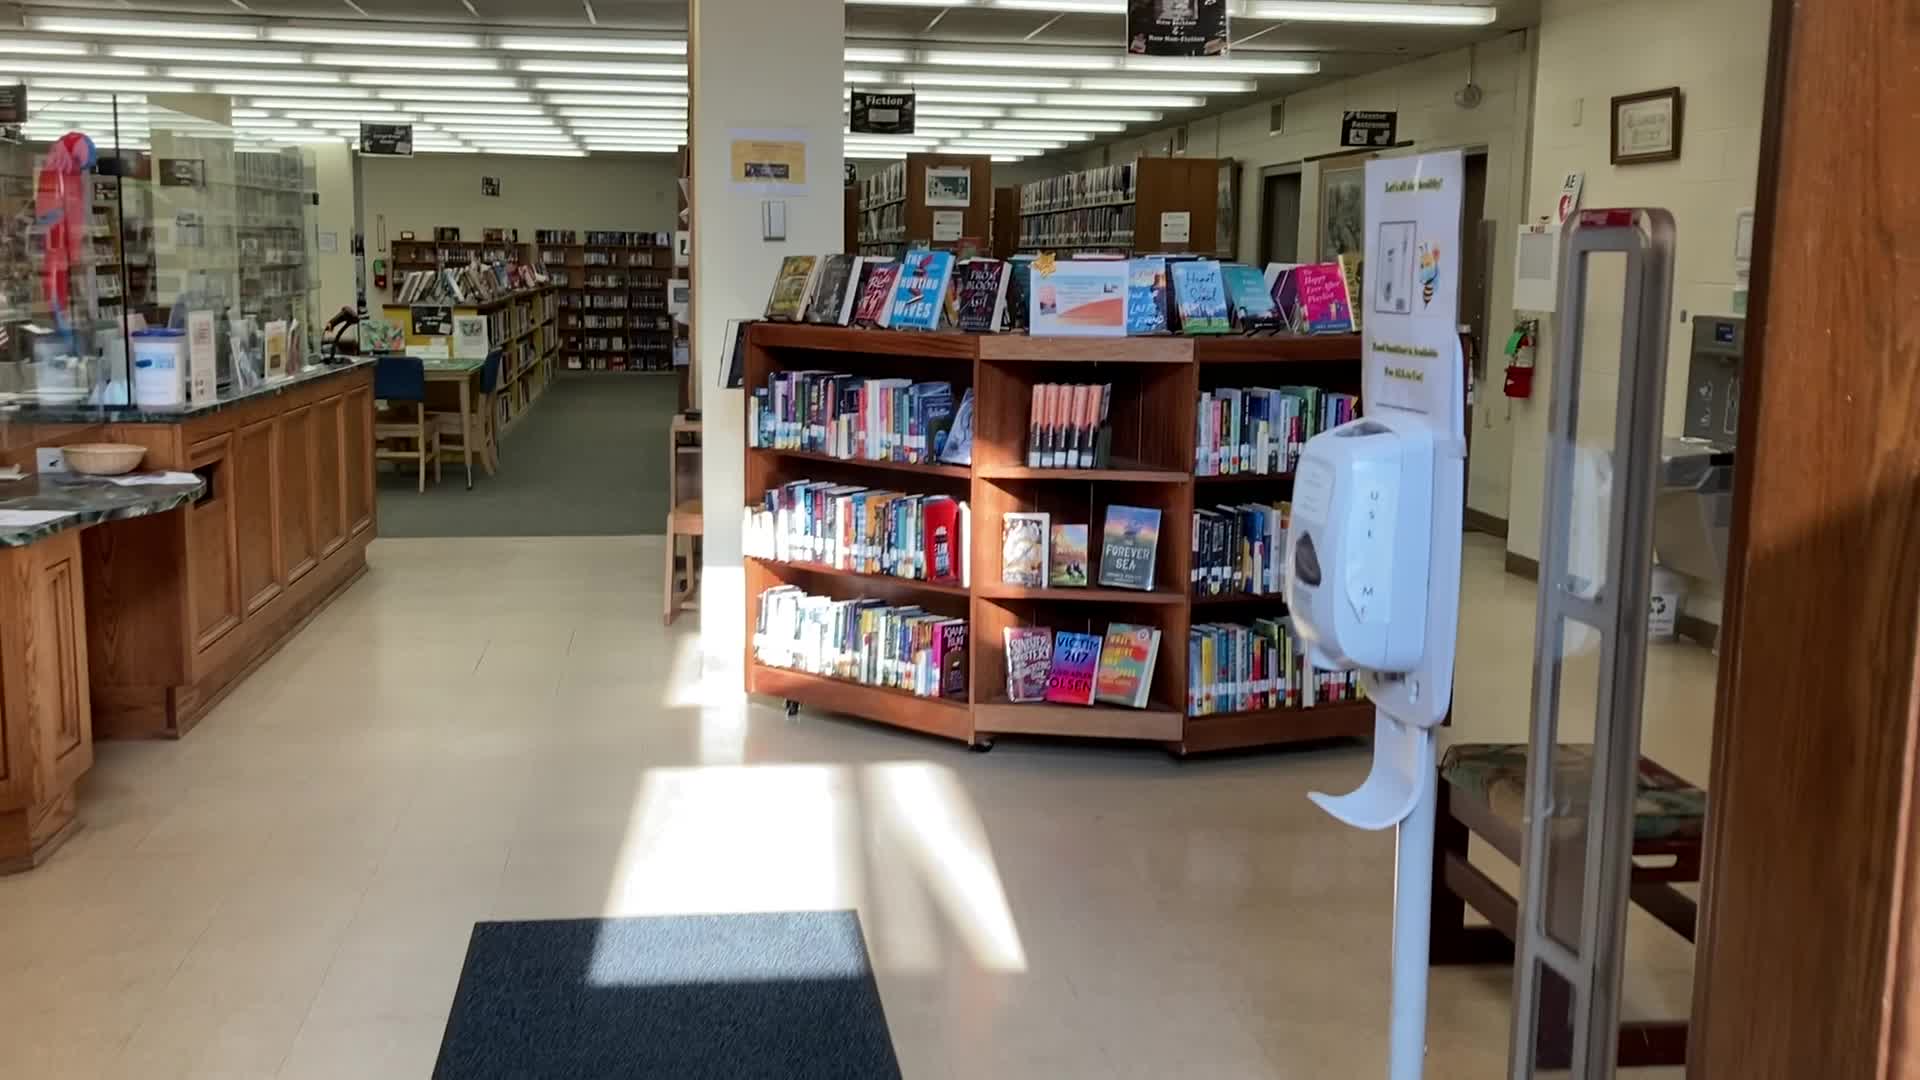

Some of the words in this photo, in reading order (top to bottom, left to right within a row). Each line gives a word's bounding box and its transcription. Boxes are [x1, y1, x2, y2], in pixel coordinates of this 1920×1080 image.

[865, 95, 904, 105] Fiction
[894, 300, 932, 319] WIVES
[1105, 544, 1151, 561] FOREVER
[1115, 558, 1137, 572] SEA
[1057, 636, 1099, 650] VICTIM
[1049, 678, 1091, 693] OLSEN
